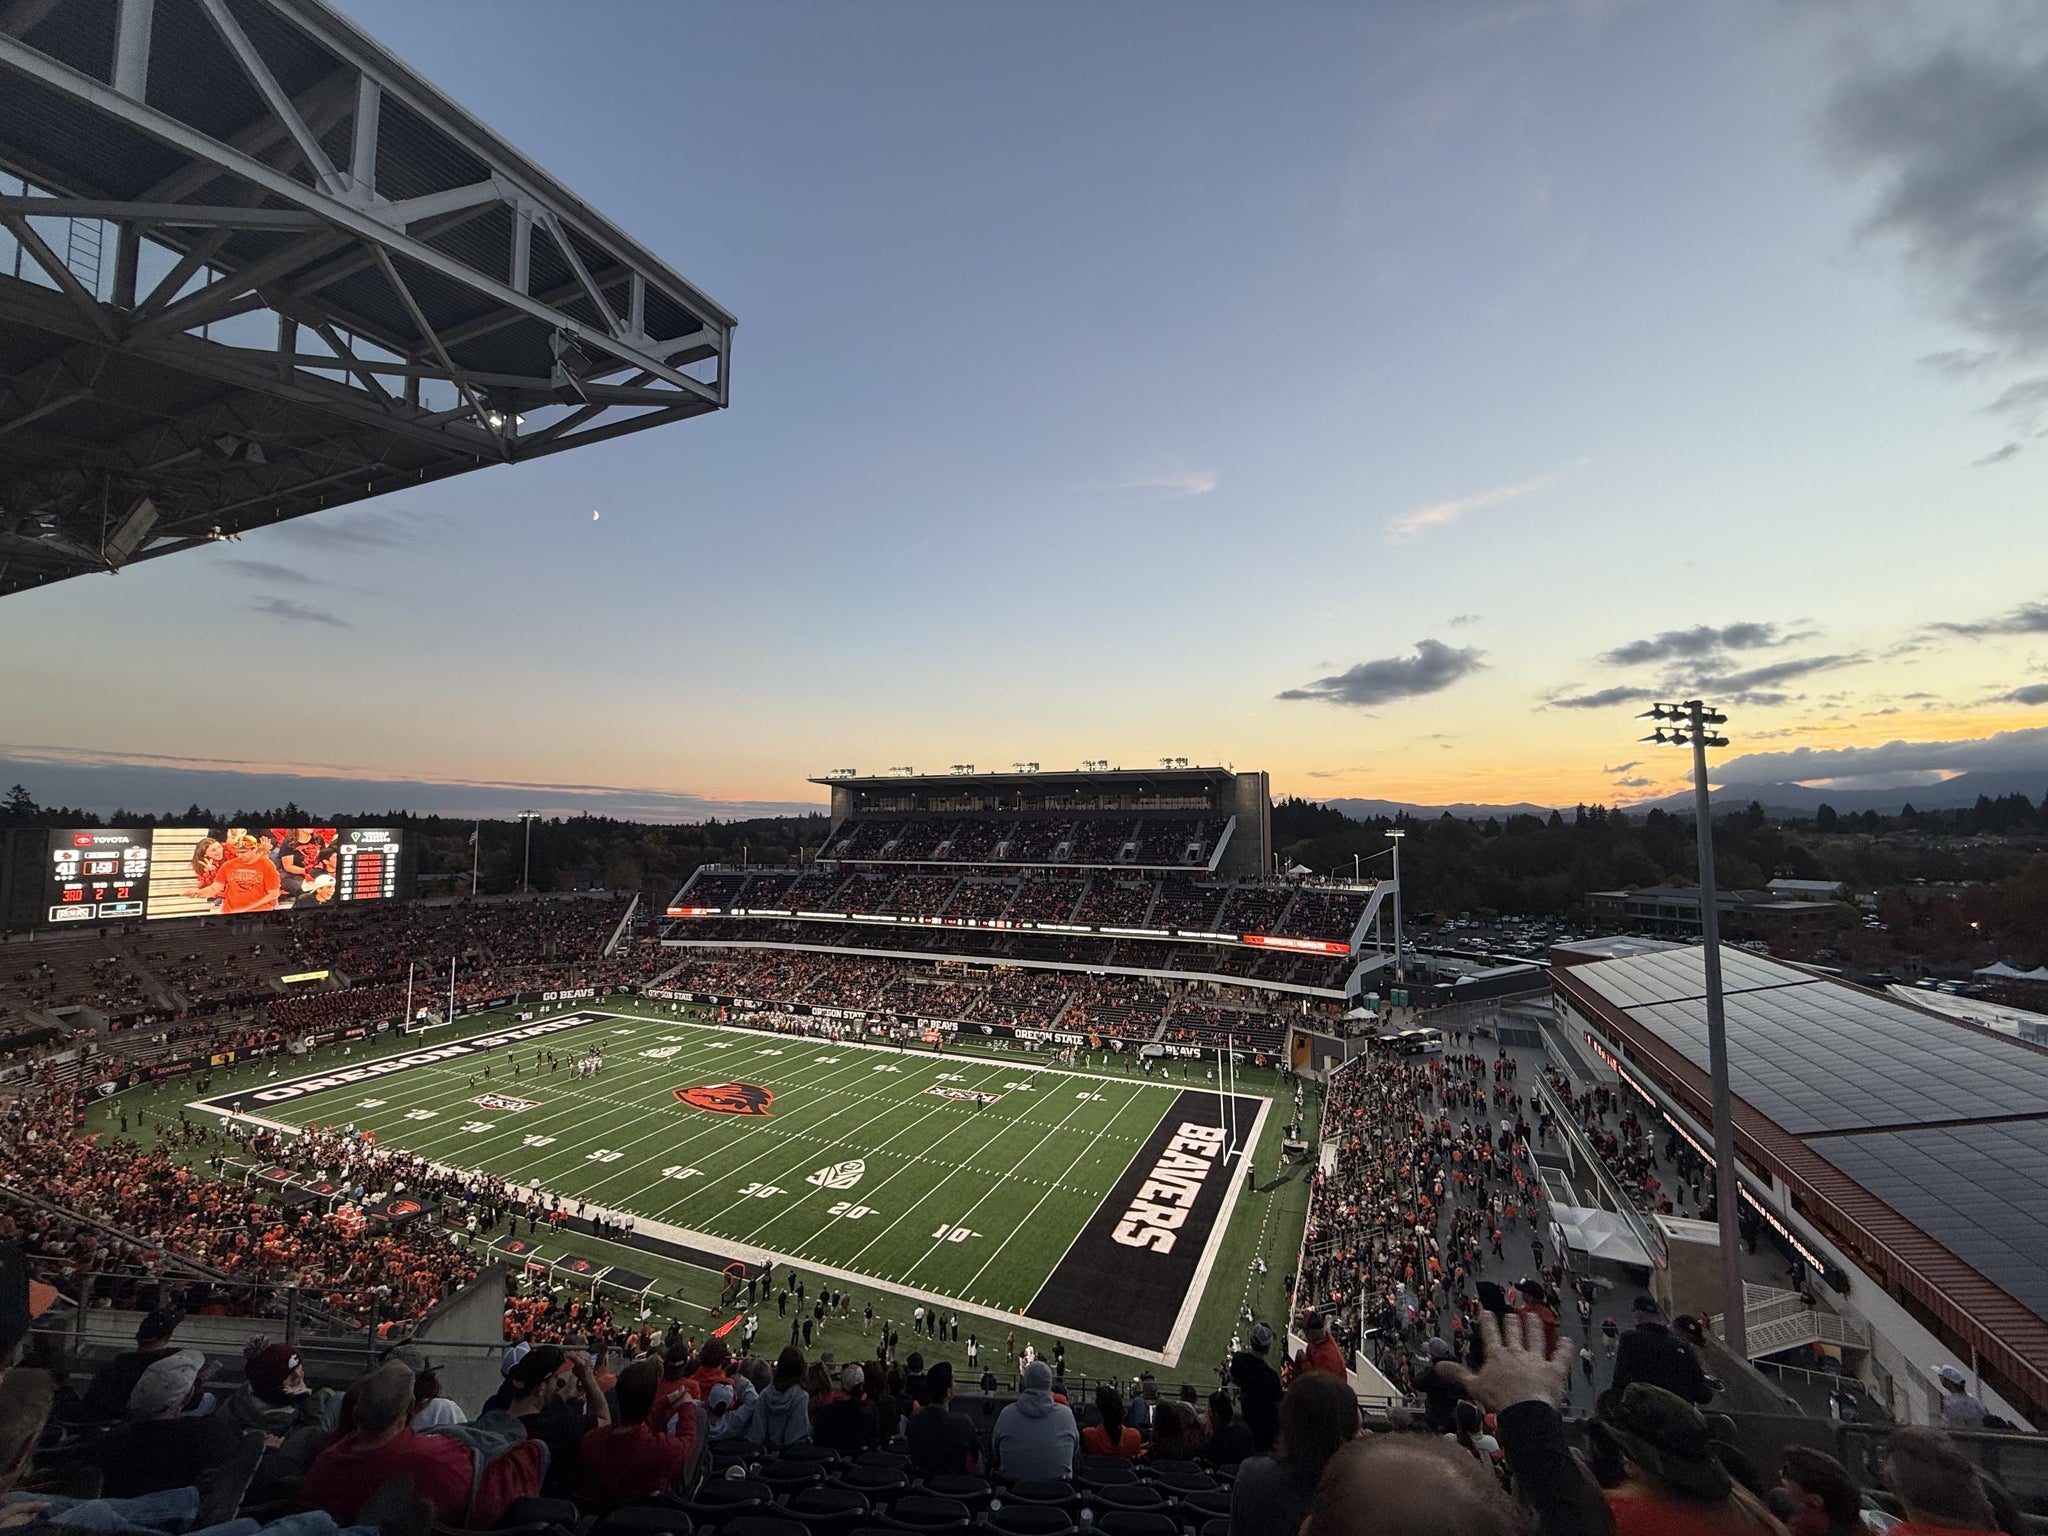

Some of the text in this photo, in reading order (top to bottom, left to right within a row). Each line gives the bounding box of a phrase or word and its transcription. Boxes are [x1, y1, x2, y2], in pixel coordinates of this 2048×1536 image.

[93, 836, 129, 844] TOYOTA
[55, 862, 77, 875] 41
[123, 860, 147, 873] 22
[63, 889, 83, 902] 3RD
[95, 888, 104, 900] 2
[117, 887, 129, 899] 21
[542, 988, 595, 1001] GO BEAVS
[930, 1020, 959, 1031] BEAVS
[1053, 1033, 1084, 1045] STATE
[253, 1015, 595, 1101] OREGON STATE
[459, 1121, 496, 1133] 30
[522, 1135, 557, 1147] 40
[585, 1149, 625, 1162] 50
[660, 1165, 699, 1180] 40
[737, 1182, 779, 1199] 30
[1111, 1121, 1228, 1255] BEAVERS
[827, 1201, 871, 1219] 20
[931, 1223, 973, 1243] 10
